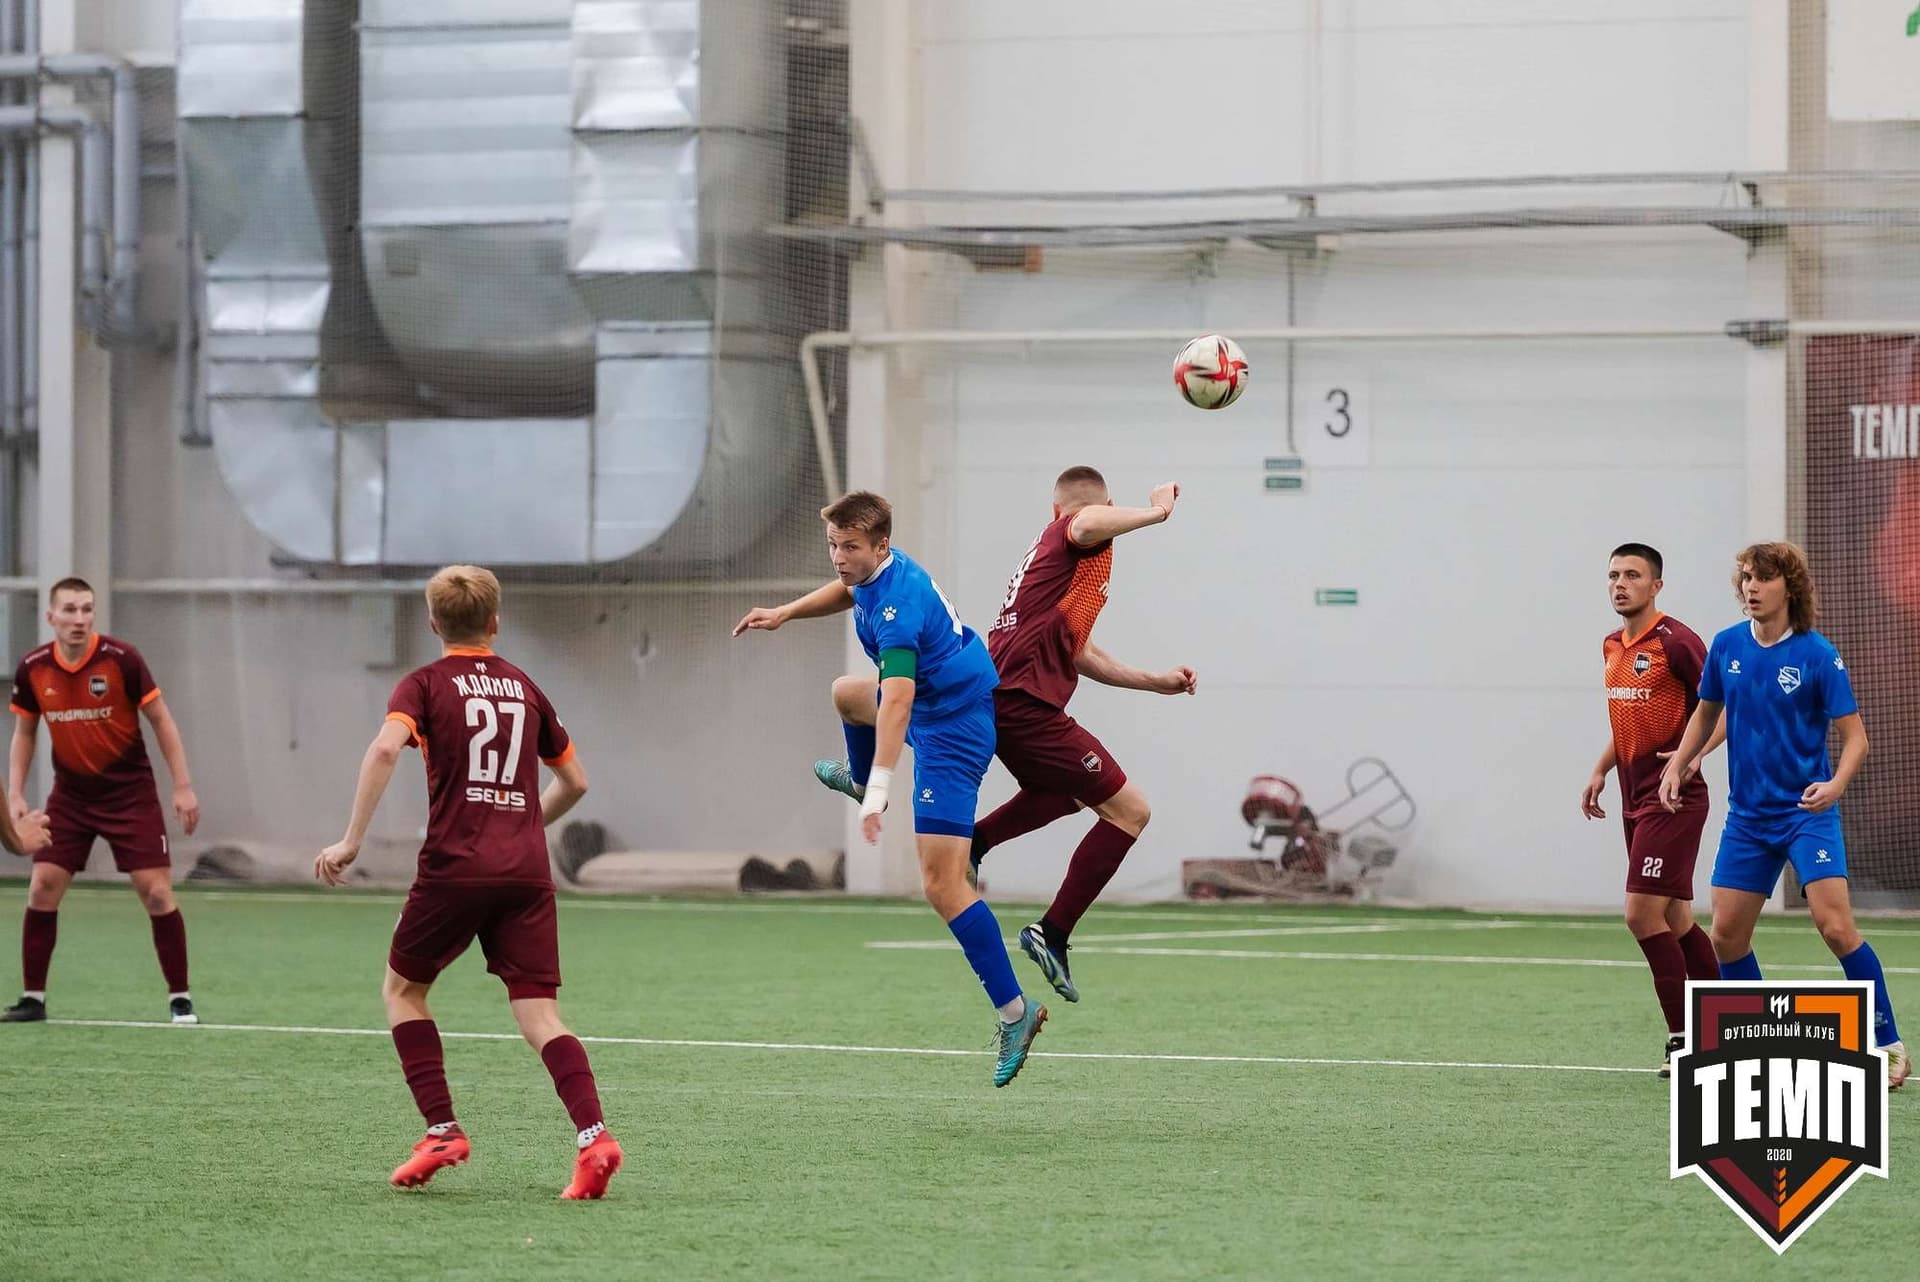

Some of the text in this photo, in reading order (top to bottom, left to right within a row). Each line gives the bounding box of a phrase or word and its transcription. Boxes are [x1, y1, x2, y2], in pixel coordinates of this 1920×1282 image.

[1325, 388, 1352, 438] 3
[465, 698, 526, 785] 27
[466, 787, 526, 806] SEUS
[1642, 856, 1663, 878] 22
